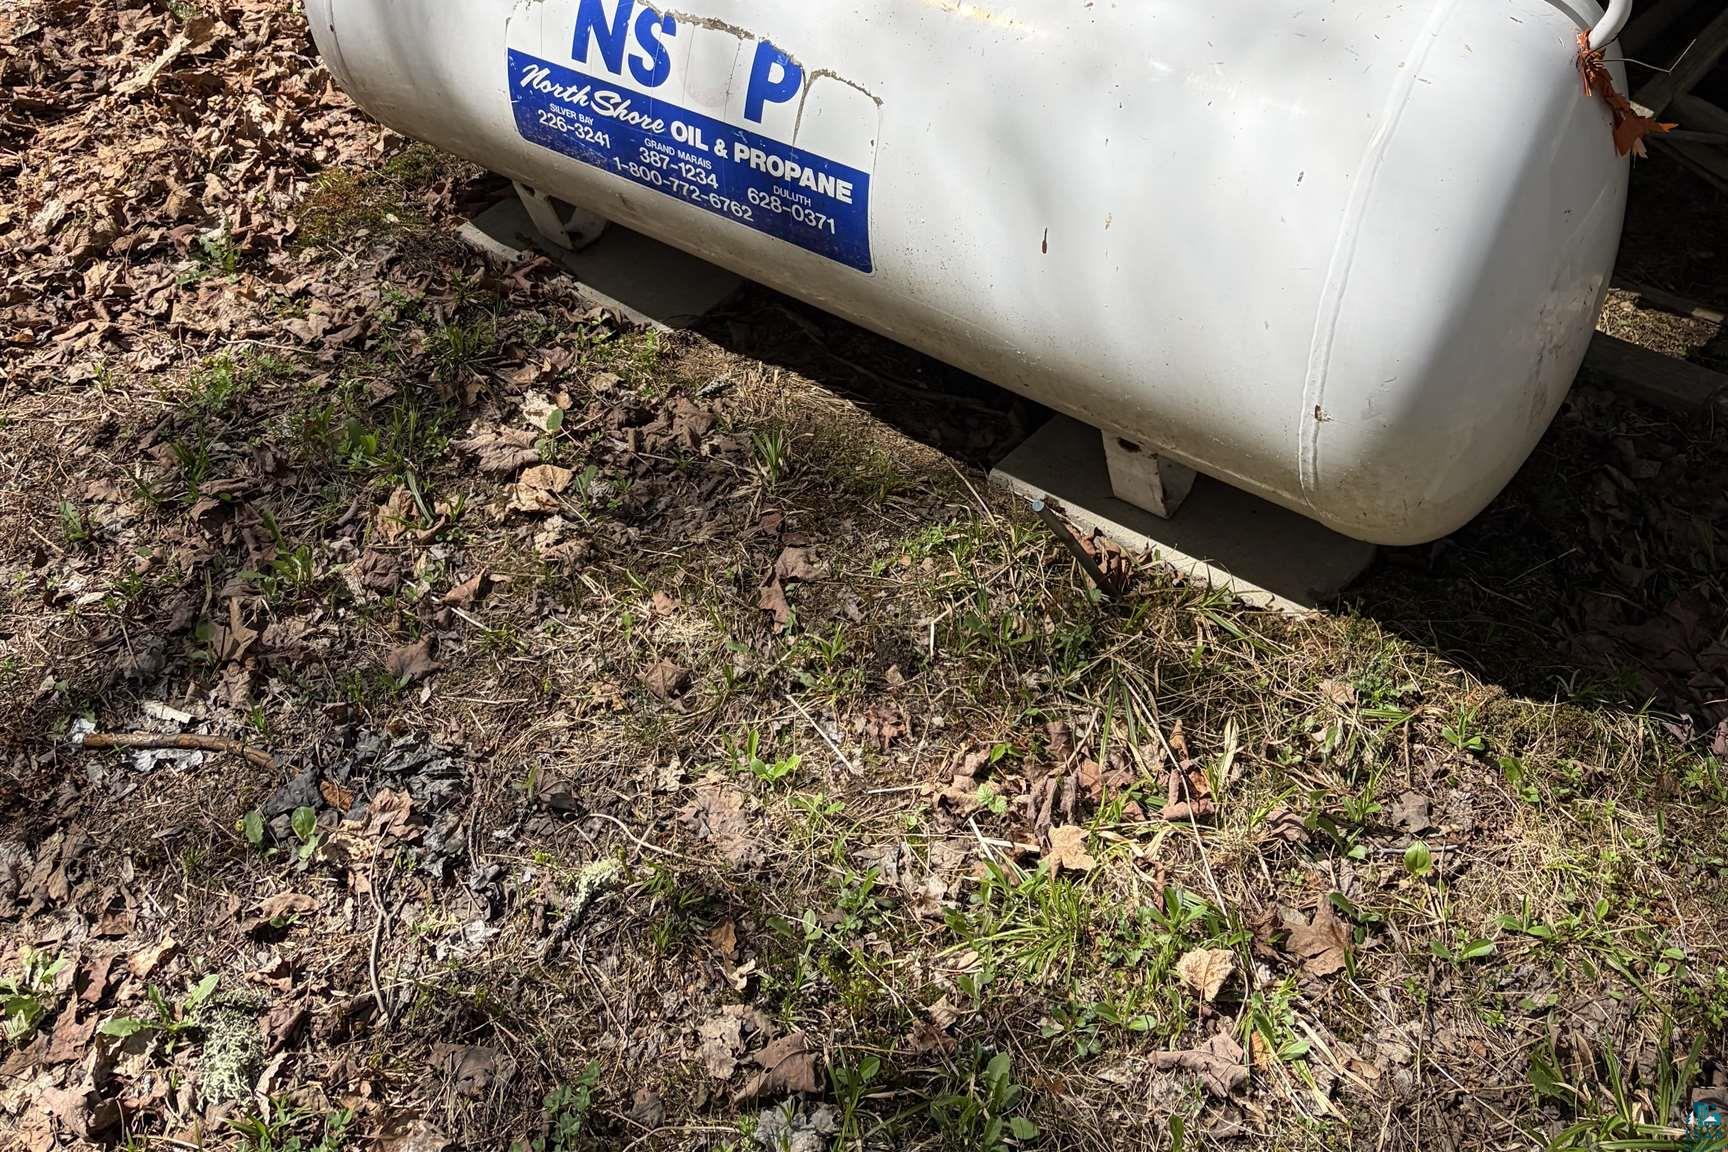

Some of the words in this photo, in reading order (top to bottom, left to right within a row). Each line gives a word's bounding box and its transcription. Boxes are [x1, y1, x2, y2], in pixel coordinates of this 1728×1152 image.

[520, 64, 591, 106] North
[590, 91, 665, 133] Shore
[671, 121, 708, 151] OIL
[714, 138, 728, 159] &
[734, 142, 853, 204] PROPANE
[538, 109, 611, 149] 226-3241
[550, 103, 576, 118] SILVER
[578, 113, 594, 126] BAY
[639, 147, 718, 189] 387-1234
[644, 138, 675, 156] GRAND
[677, 151, 712, 170] MARAIS
[613, 156, 754, 222] 1-800-772-6762
[773, 185, 812, 207] DULUTH
[747, 187, 836, 235] 628-0371
